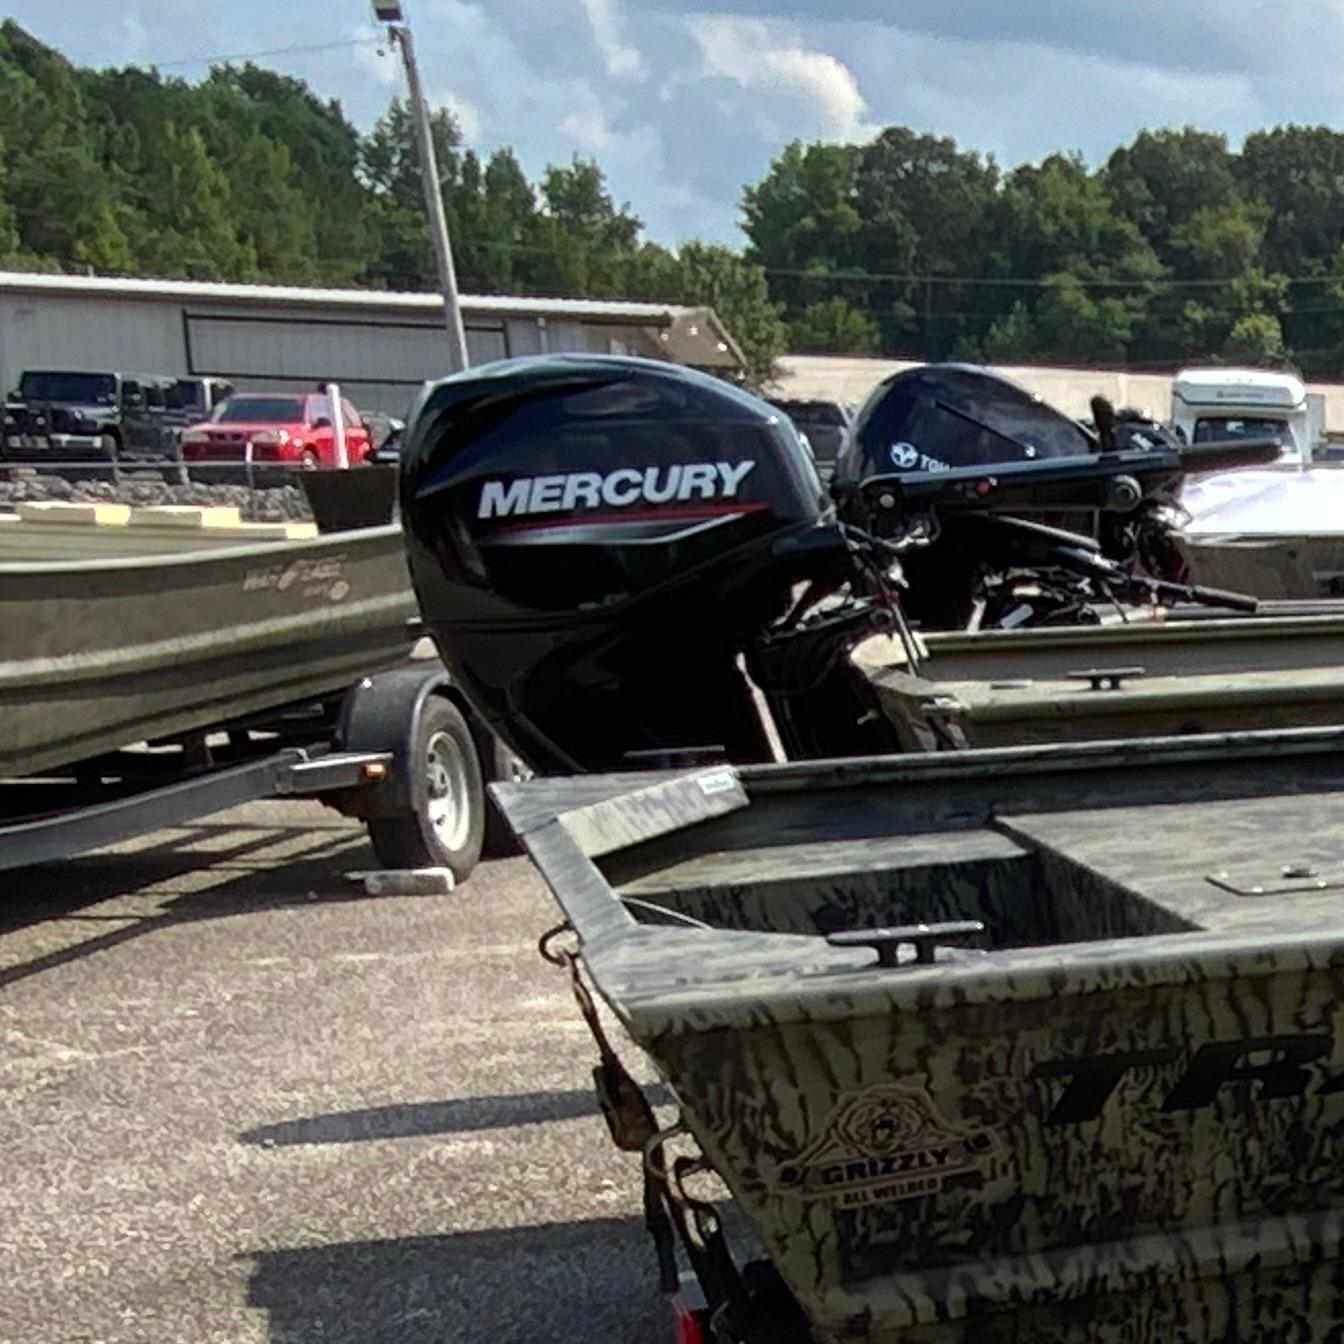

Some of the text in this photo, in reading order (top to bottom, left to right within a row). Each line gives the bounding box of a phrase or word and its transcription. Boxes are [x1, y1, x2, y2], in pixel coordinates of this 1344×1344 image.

[477, 460, 755, 519] MERCURY
[822, 1148, 949, 1185] GRIZZLY
[843, 1177, 939, 1206] ALL WELDED
